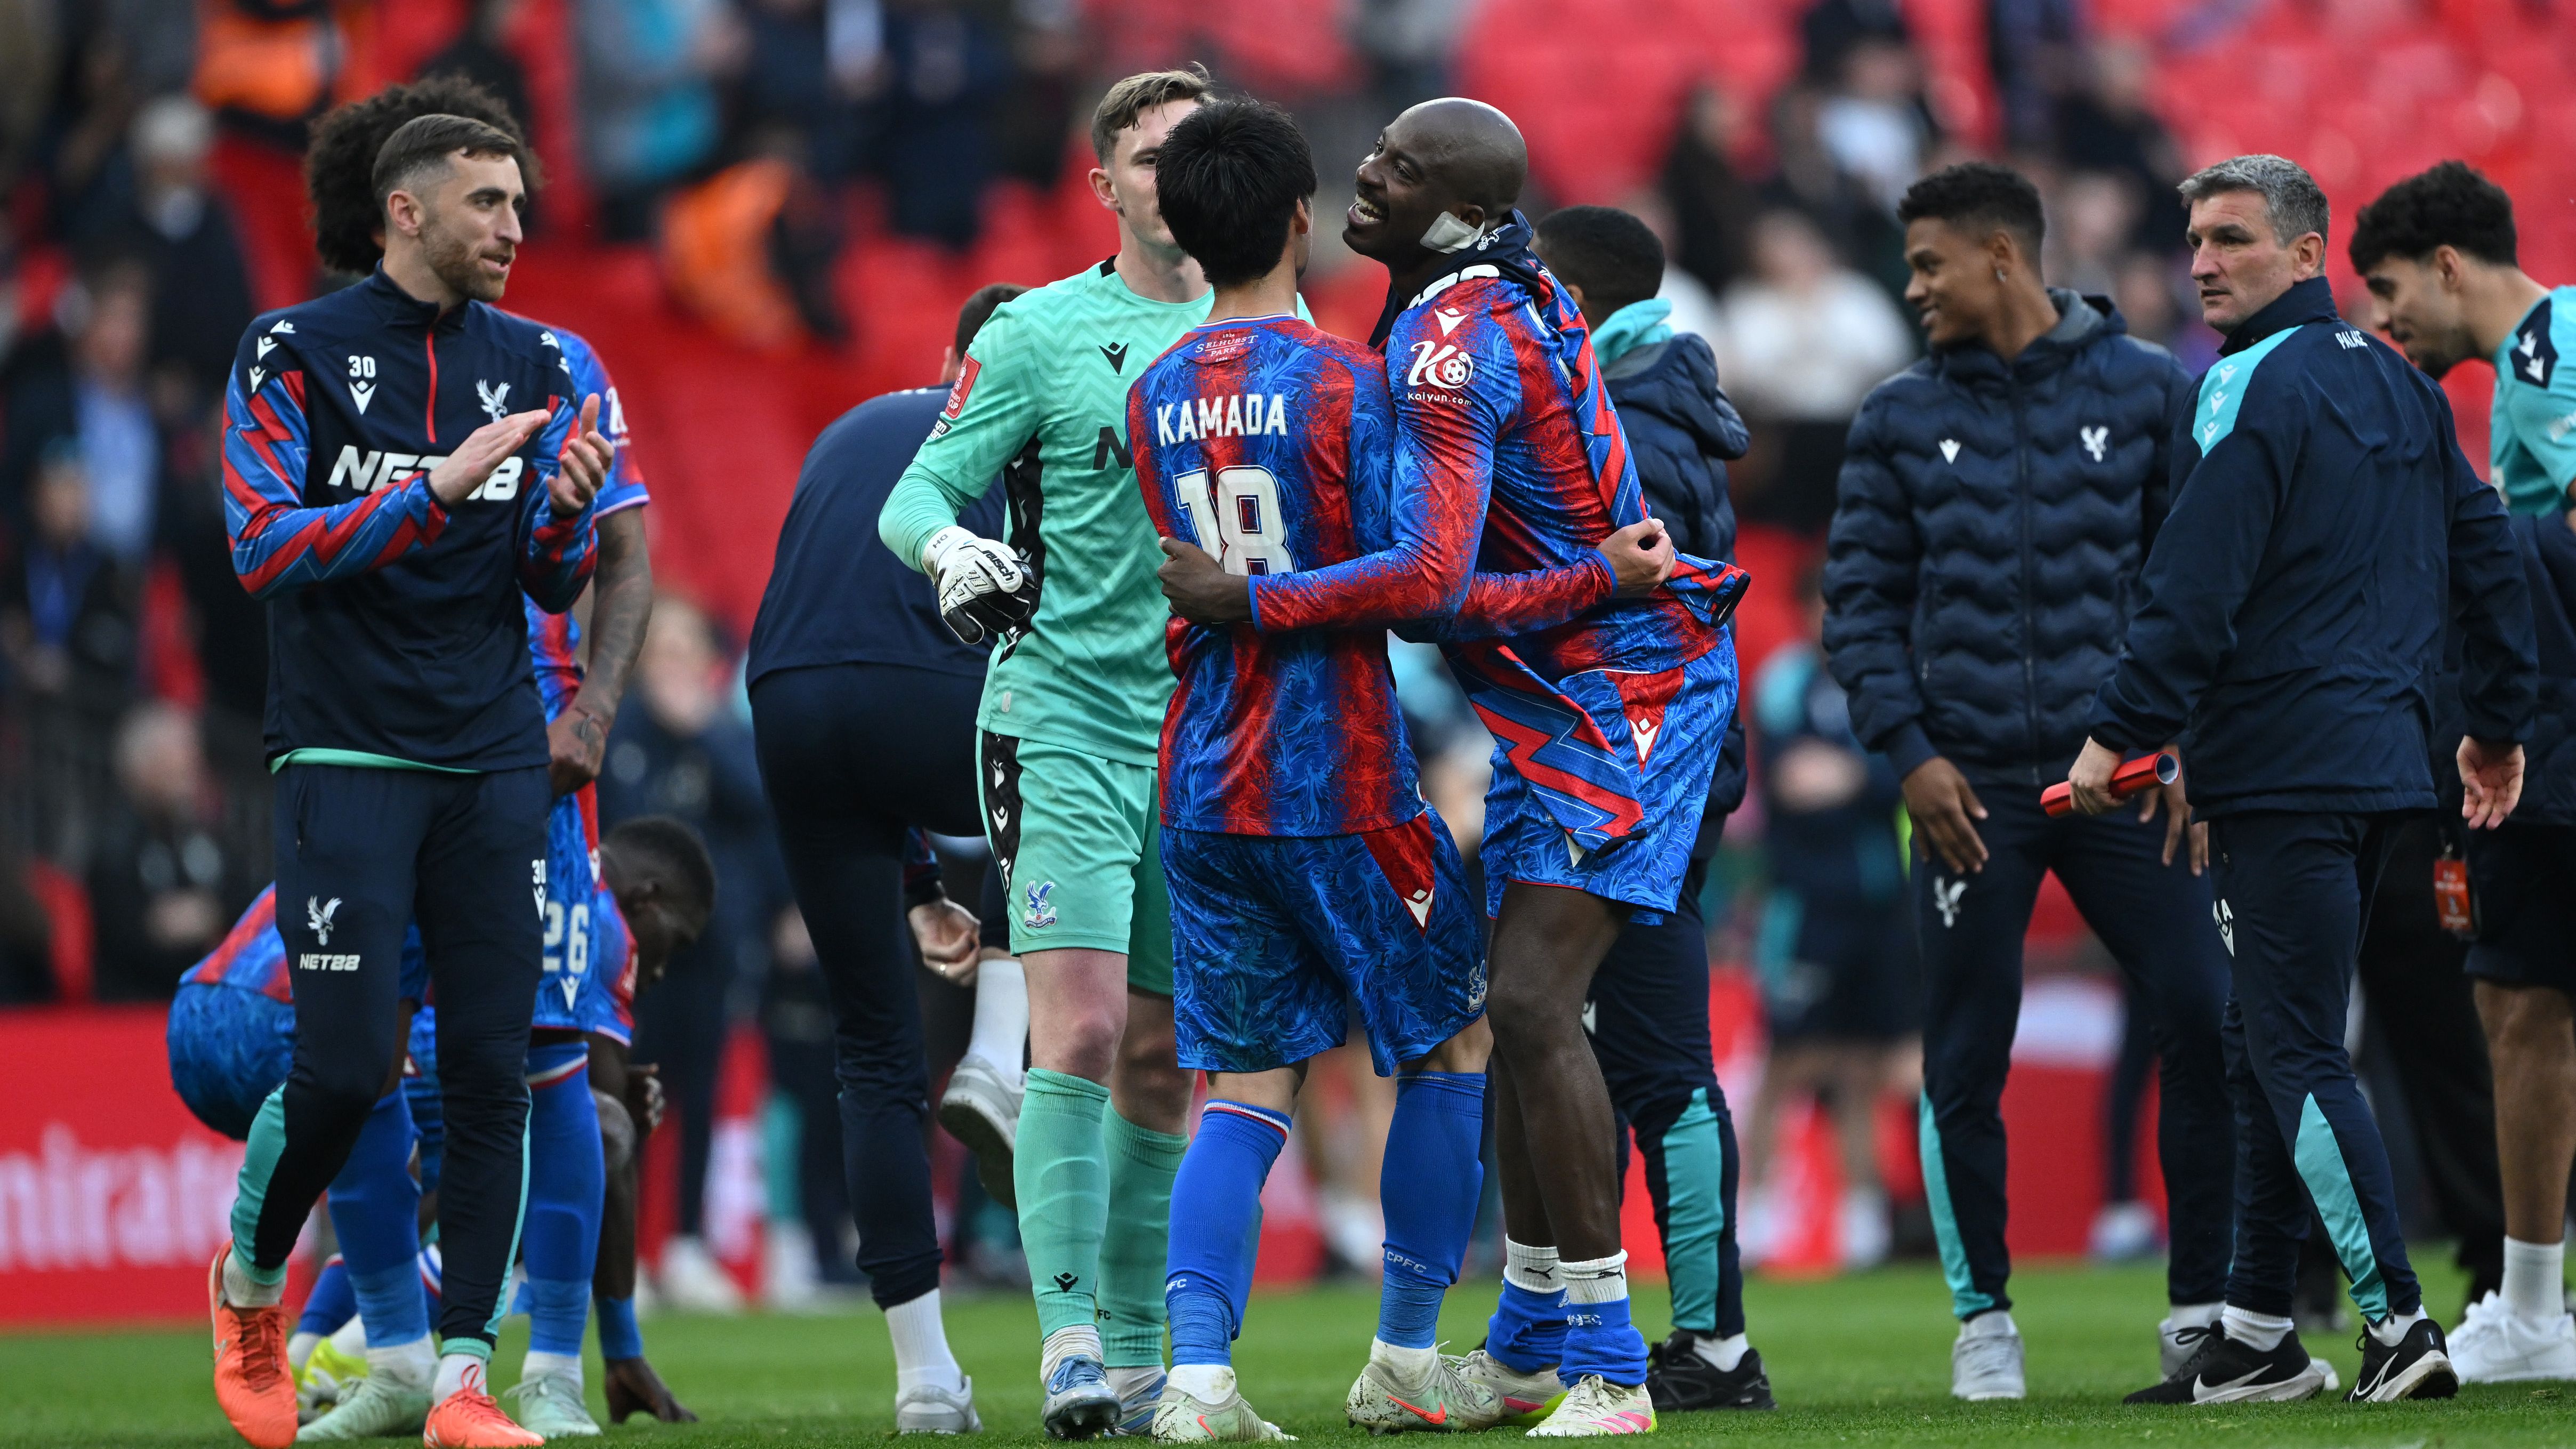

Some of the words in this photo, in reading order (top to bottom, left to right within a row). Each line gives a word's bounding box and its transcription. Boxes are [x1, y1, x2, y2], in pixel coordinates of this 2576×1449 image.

[1195, 335, 1258, 352] SELHURST
[1211, 347, 1237, 357] PARK
[348, 355, 376, 378] 30
[1407, 392, 1471, 405] kaiyun.com
[1156, 393, 1287, 447] KAMADA
[327, 445, 523, 500] NE8
[1173, 465, 1298, 576] 18
[532, 859, 546, 884] 30
[543, 901, 589, 973] 26
[300, 953, 360, 971] NET88
[1387, 1251, 1427, 1273] CPFC
[1097, 1309, 1111, 1320] FC
